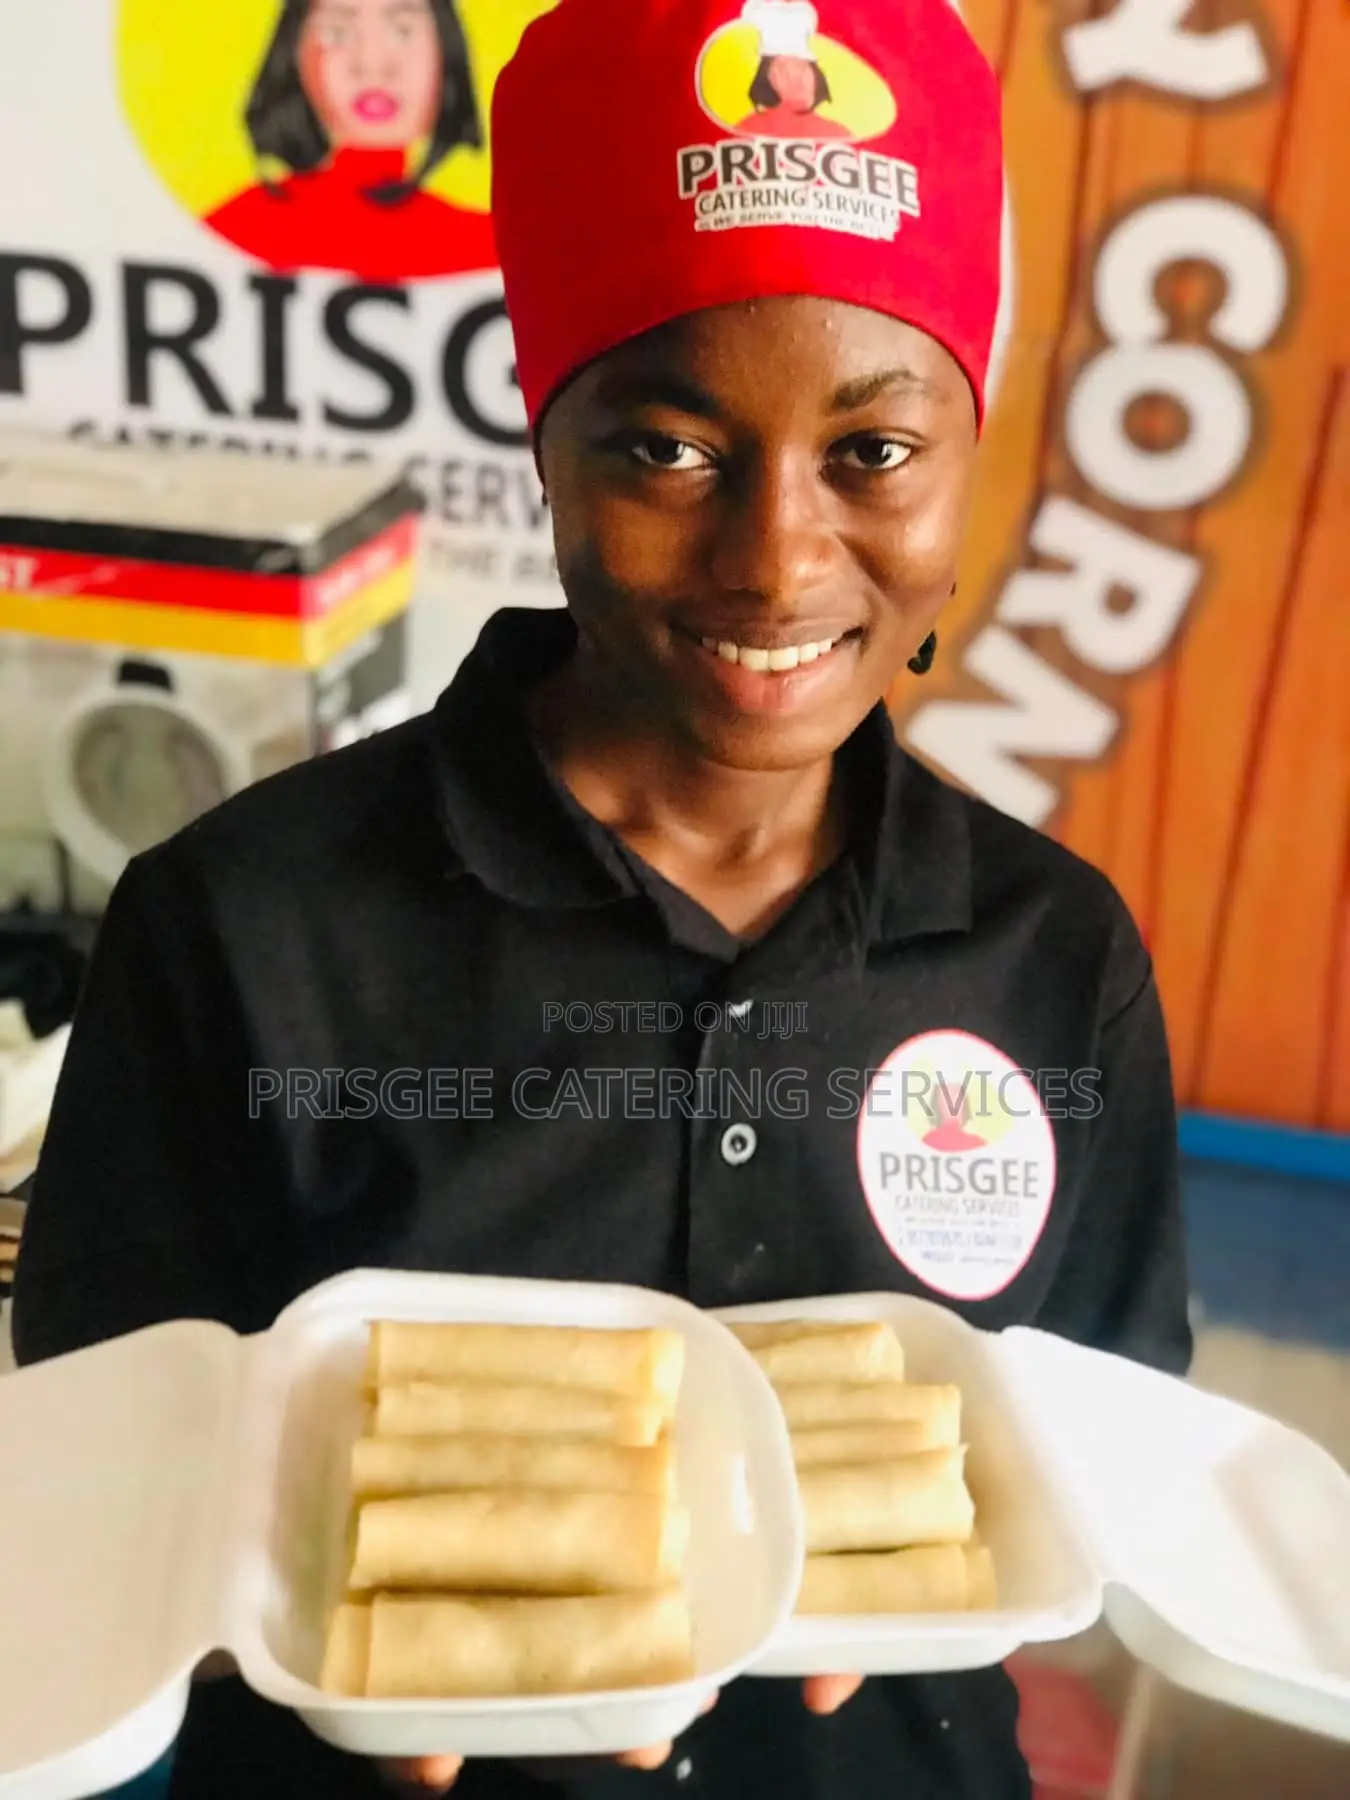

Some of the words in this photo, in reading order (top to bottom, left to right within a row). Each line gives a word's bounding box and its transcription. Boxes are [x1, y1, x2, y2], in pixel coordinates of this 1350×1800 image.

[681, 142, 917, 210] PRISGEE
[699, 188, 806, 214] CATERING
[0, 248, 532, 448] PRISG
[907, 195, 1288, 828] CORN
[879, 1152, 1040, 1200] PRISGEE
